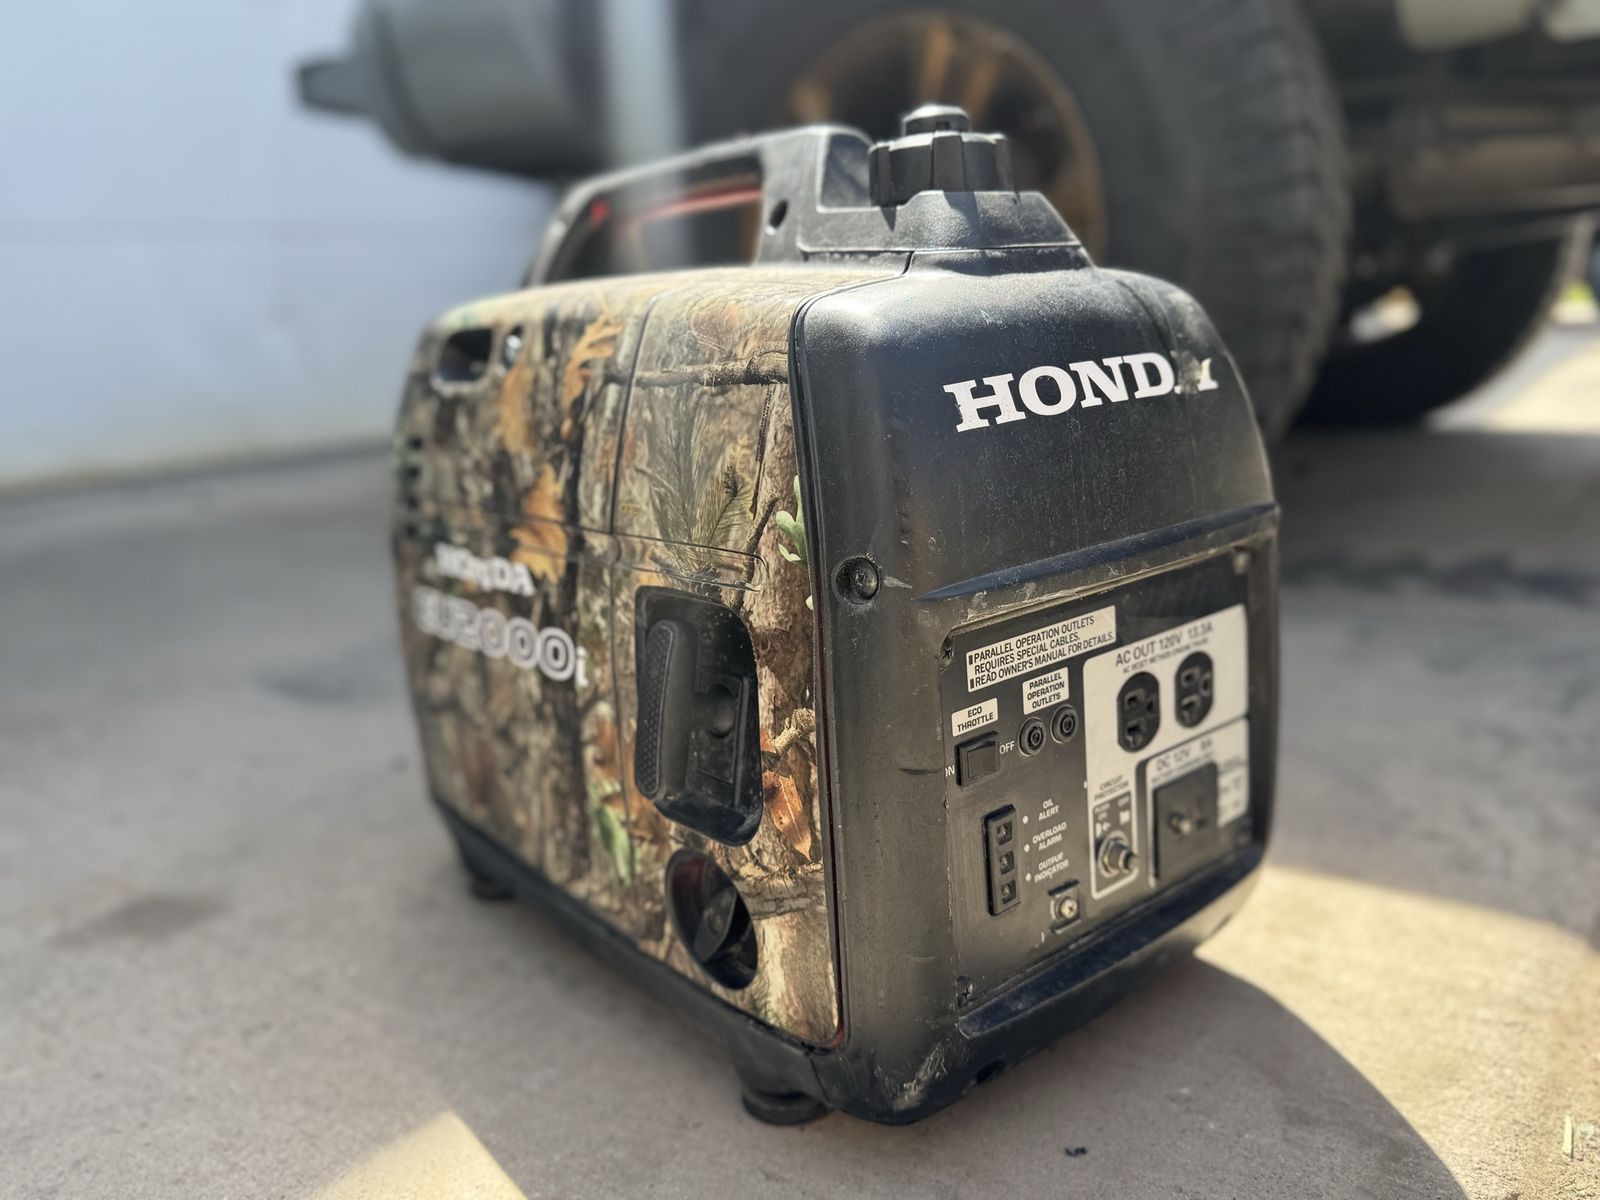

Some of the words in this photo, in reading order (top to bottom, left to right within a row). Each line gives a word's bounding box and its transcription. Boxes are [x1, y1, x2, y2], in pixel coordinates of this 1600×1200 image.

[974, 642, 1014, 663] PARALLEL
[1015, 627, 1060, 649] OPERATION
[1061, 615, 1095, 633] OUTLETS
[1116, 650, 1131, 667] AC
[1133, 641, 1156, 660] OUT
[1159, 631, 1183, 650] 120V
[974, 654, 1015, 675] REQUIRES
[1017, 643, 1050, 661] SPECIAL
[1050, 632, 1080, 650] CABLES.
[975, 671, 997, 687] READ
[998, 659, 1034, 679] OWNER'S
[1034, 648, 1067, 667] MANUAL
[1068, 643, 1082, 657] FOR
[1083, 632, 1114, 650] DETAILS.
[1027, 681, 1065, 701] OPERATION
[1029, 672, 1062, 690] PARALLEL
[1031, 692, 1061, 709] OUTLETS
[957, 712, 994, 732] THROTTLE
[967, 706, 983, 718] ECO
[1000, 740, 1015, 754] OFF
[1038, 805, 1059, 821] ALERT
[1042, 798, 1054, 809] OIL
[1032, 821, 1067, 844] OVERLOAD
[1038, 833, 1062, 851] ALARM
[1034, 859, 1069, 883] INDICATOR
[1038, 851, 1064, 871] OUTPUT
